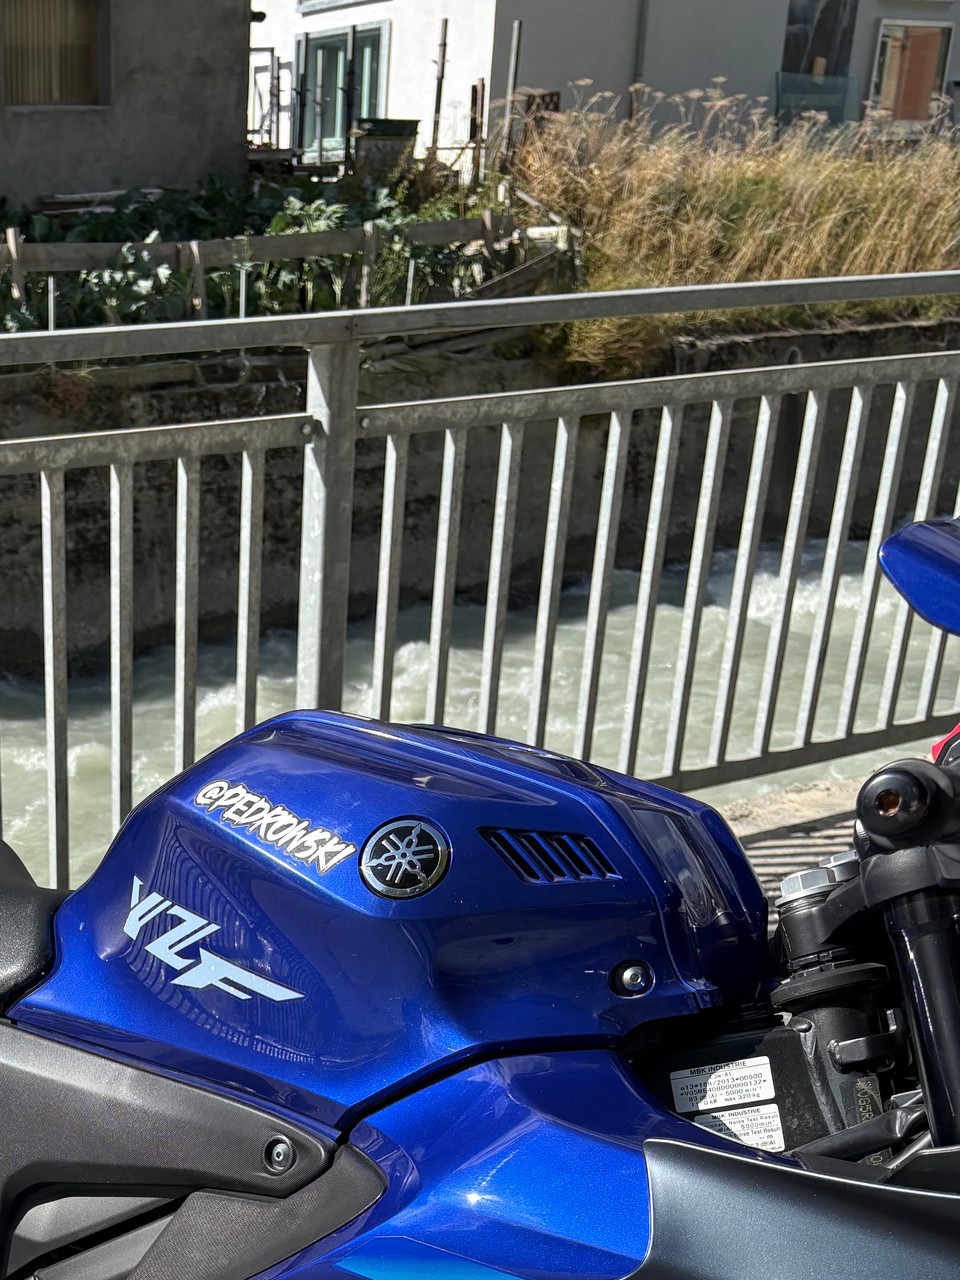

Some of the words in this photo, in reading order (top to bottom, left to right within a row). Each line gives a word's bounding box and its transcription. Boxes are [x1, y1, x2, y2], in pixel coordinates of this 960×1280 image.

[195, 781, 356, 874] @PEDROWSKI
[123, 875, 307, 1003] YZF
[708, 1060, 747, 1072] INDUSTRIE
[728, 1108, 761, 1118] INDUSTRIE
